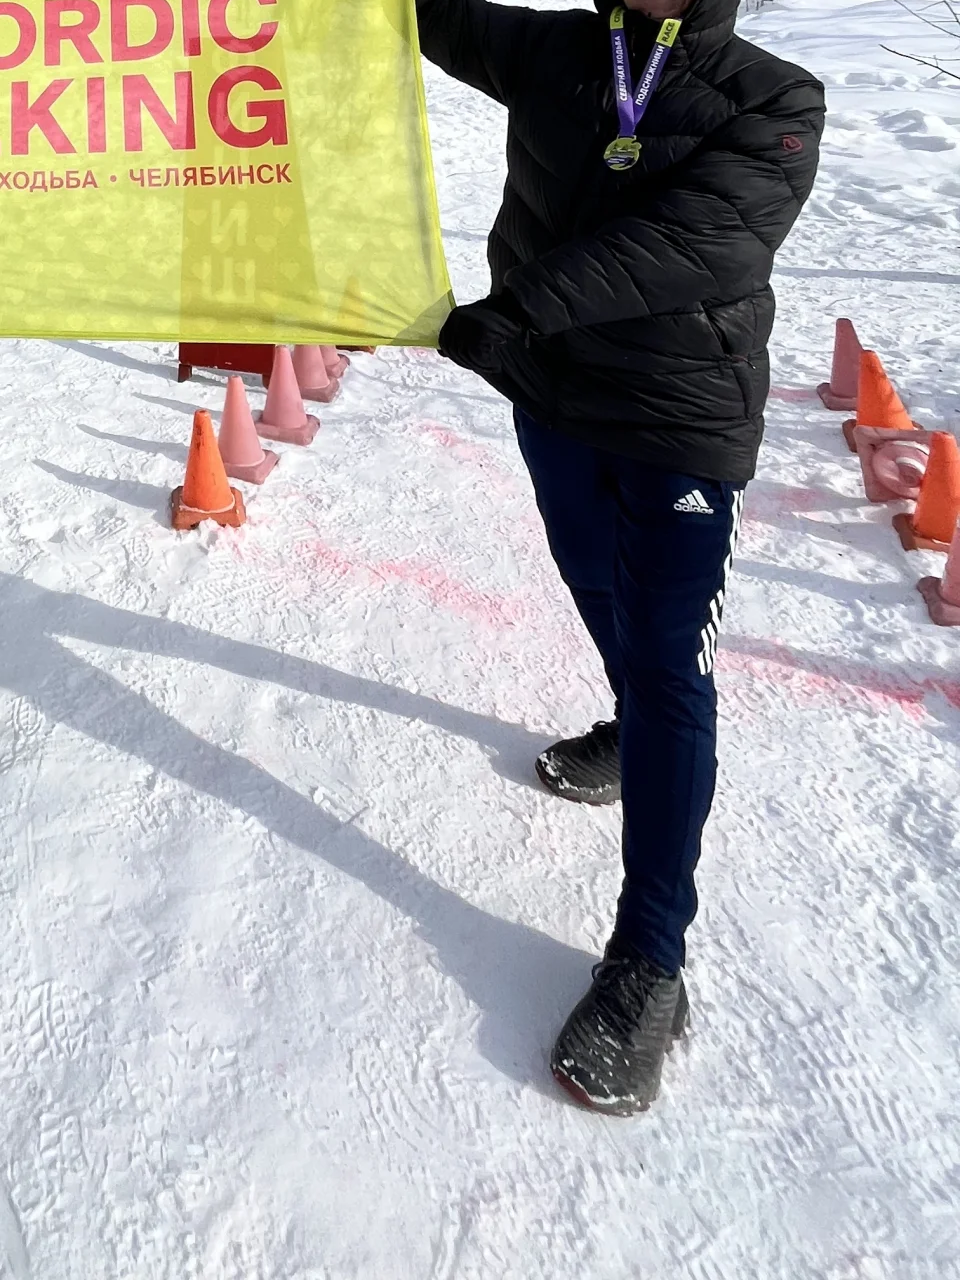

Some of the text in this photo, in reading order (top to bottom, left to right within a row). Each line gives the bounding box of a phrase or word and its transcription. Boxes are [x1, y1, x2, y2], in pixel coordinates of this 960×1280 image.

[661, 22, 676, 43] RACE
[613, 35, 625, 64] ХОДЬБА
[617, 64, 628, 102] СЕВЕРНАЯ
[634, 45, 666, 106] ПОДСНЕЖНИКИ
[129, 163, 292, 189] ЧЕЛЯБИНСК
[673, 503, 714, 515] adidas
